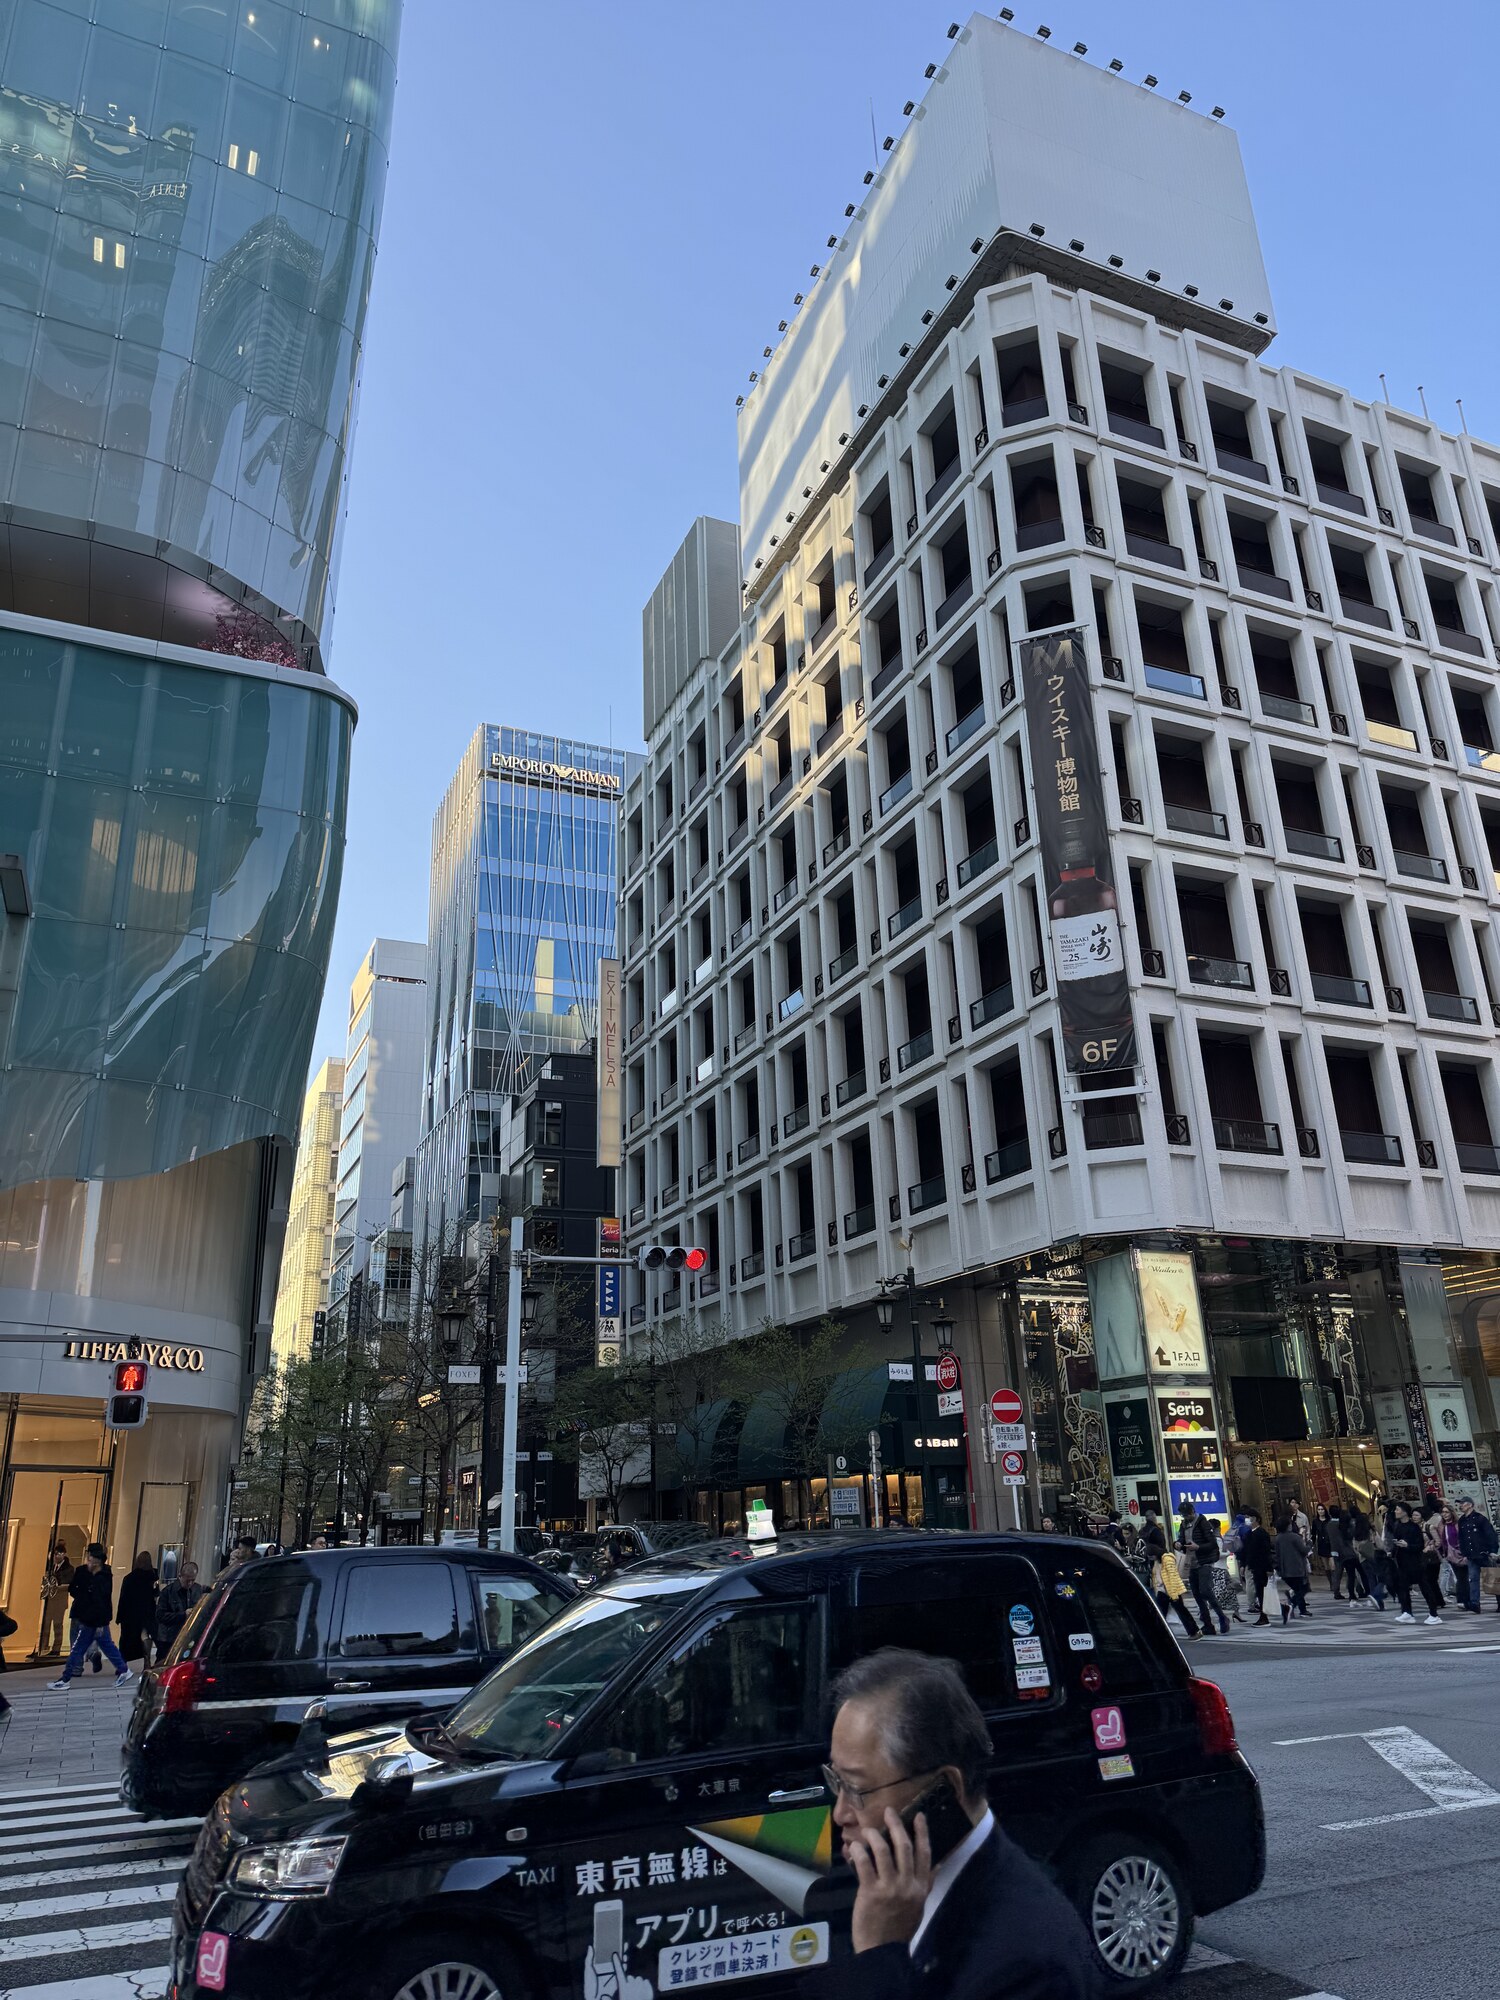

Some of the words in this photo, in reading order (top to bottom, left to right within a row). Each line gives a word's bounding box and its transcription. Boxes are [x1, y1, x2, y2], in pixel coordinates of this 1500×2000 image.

[1047, 675, 1080, 812] ウイスキー博物館
[492, 752, 553, 775] EMPORIO
[571, 769, 620, 788] ARMANI
[1060, 936, 1089, 945] YAMAZAKI
[1068, 953, 1080, 962] 25
[606, 970, 616, 1087] EXITMELSA
[1082, 1038, 1118, 1063] 6F
[601, 1246, 619, 1254] Seria
[605, 1271, 614, 1311] PLAZA
[1058, 1315, 1085, 1324] STORE
[67, 1342, 206, 1372] TIFFAY&CO.
[1172, 1351, 1200, 1361] 1F入口
[450, 1370, 479, 1378] FOXEY
[941, 1366, 956, 1379] 消火栓
[1168, 1401, 1204, 1416] Seria
[1171, 1443, 1189, 1461] M
[1180, 1491, 1217, 1502] PLAZA
[1081, 1638, 1092, 1646] Pay
[698, 1778, 741, 1797] 大東京
[515, 1867, 556, 1888] TAXI
[575, 1846, 728, 1896] 東京無線は
[635, 1905, 786, 1949] アプリで呼べる!
[670, 1933, 781, 1965] クレジットカード
[670, 1954, 779, 1985] 登録で簡単決済!
